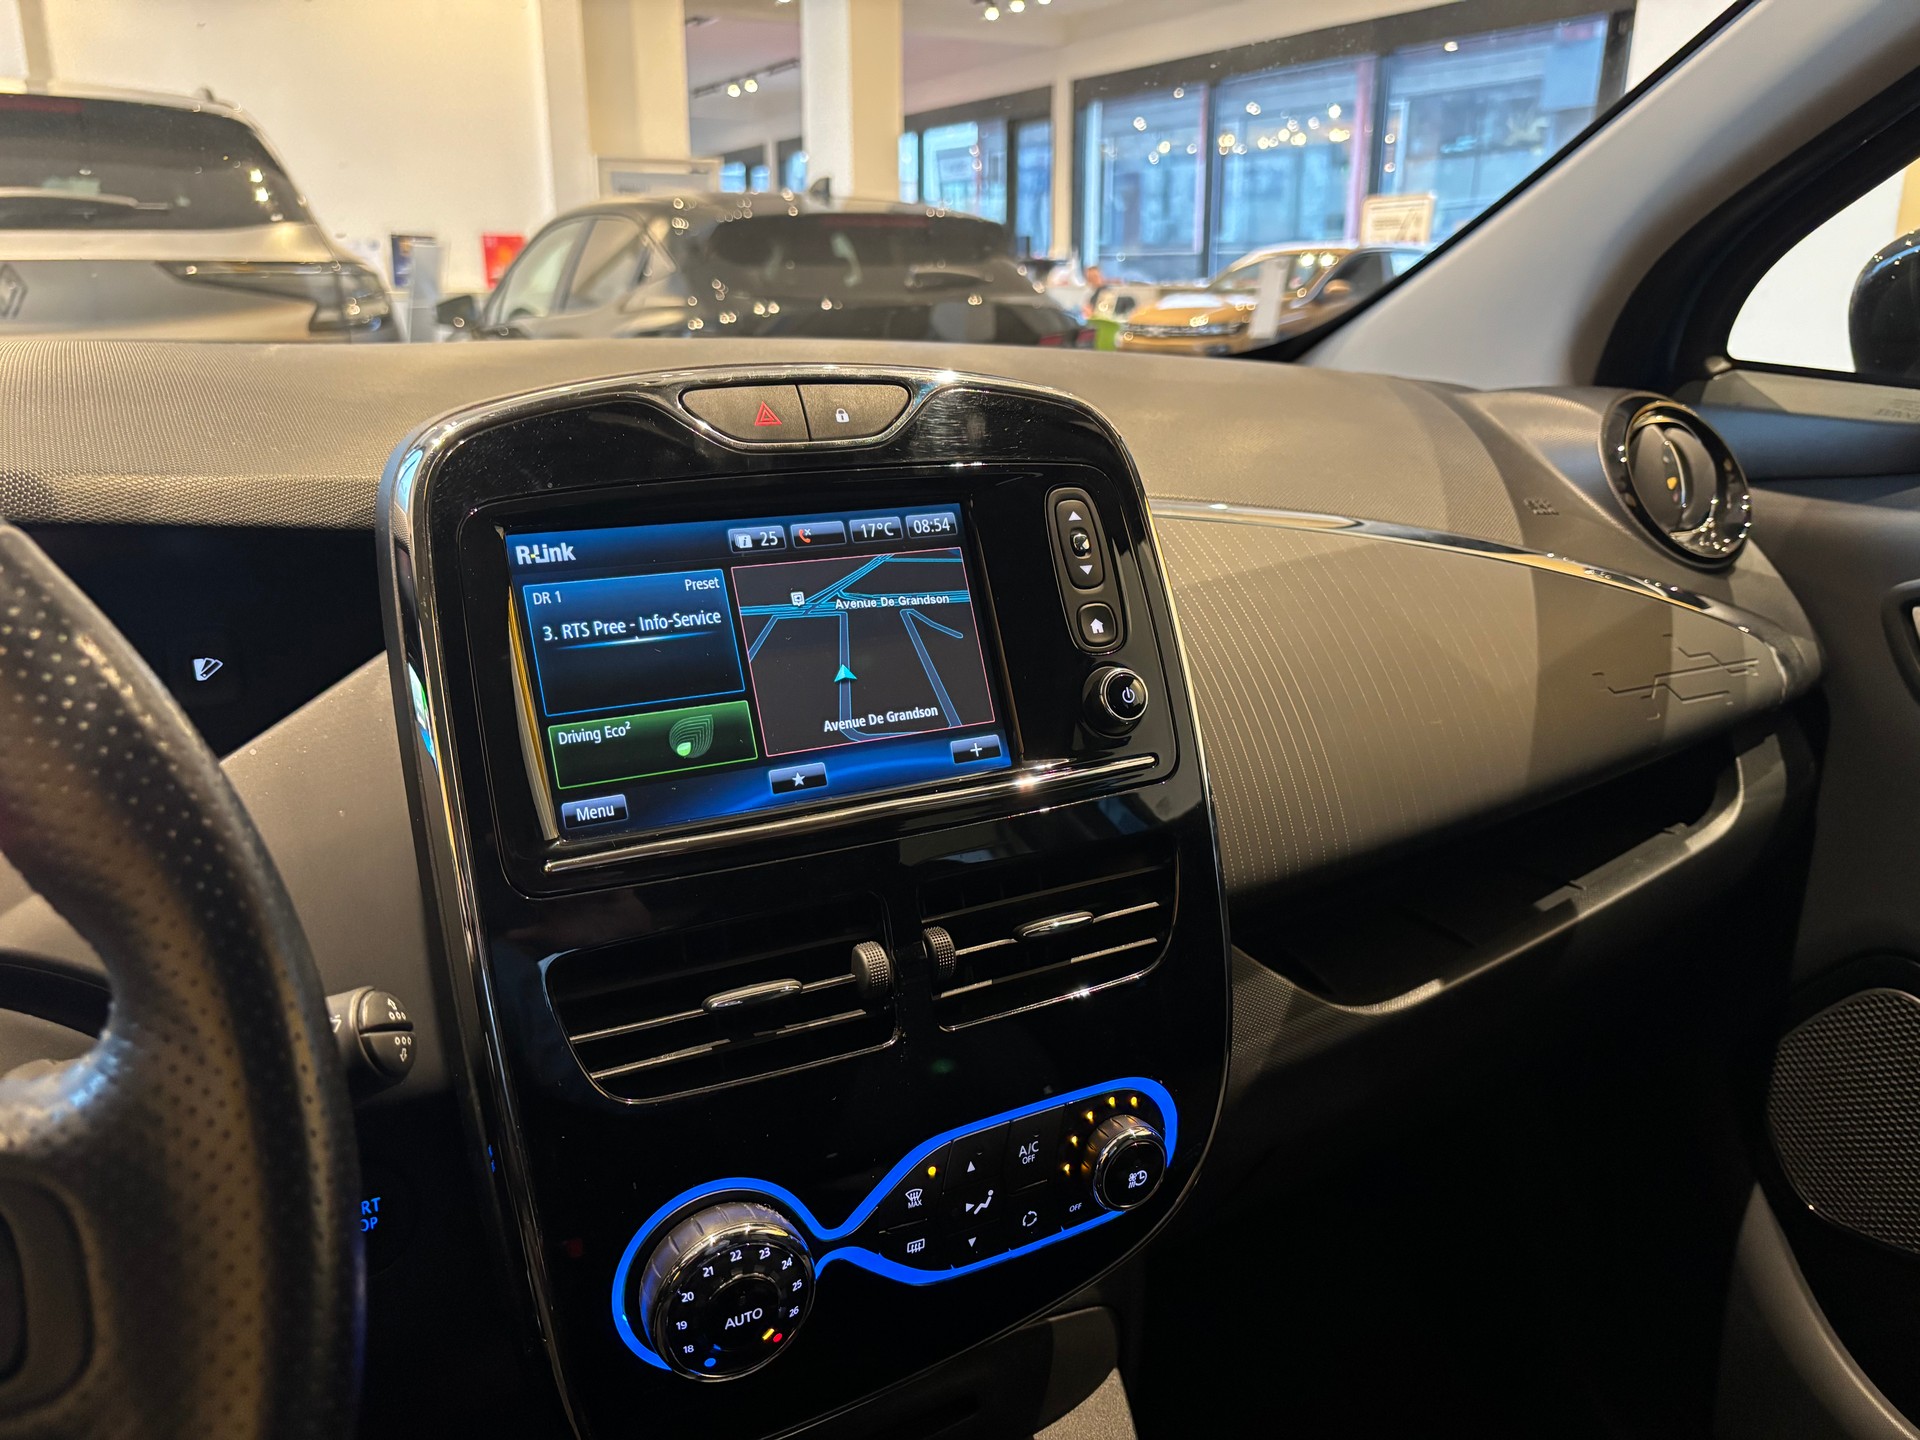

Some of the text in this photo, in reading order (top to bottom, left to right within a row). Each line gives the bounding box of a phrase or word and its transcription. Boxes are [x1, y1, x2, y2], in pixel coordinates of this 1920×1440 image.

[860, 521, 894, 539] 17°C
[913, 517, 950, 534] 08:54
[759, 531, 778, 547] 25
[684, 577, 720, 591] Preset
[532, 590, 562, 605] DR 1
[835, 594, 950, 610] Avenue De Grandson
[542, 626, 558, 642] 3.
[561, 622, 590, 639] RTS
[594, 619, 626, 636] Pree
[639, 610, 722, 632] Info-Service
[823, 706, 939, 732] Avenue De Grandson
[558, 728, 602, 745] Driving
[576, 803, 615, 822] Menu
[1018, 1141, 1039, 1158] A/C
[1022, 1153, 1036, 1165] OFF
[361, 1197, 381, 1215] RT
[907, 1199, 923, 1209] MAX
[1069, 1202, 1083, 1213] OFF
[360, 1216, 378, 1232] OP
[675, 1247, 803, 1354] 18 19 20 21 22 23 24 25 26
[724, 1307, 763, 1330] AUTO
